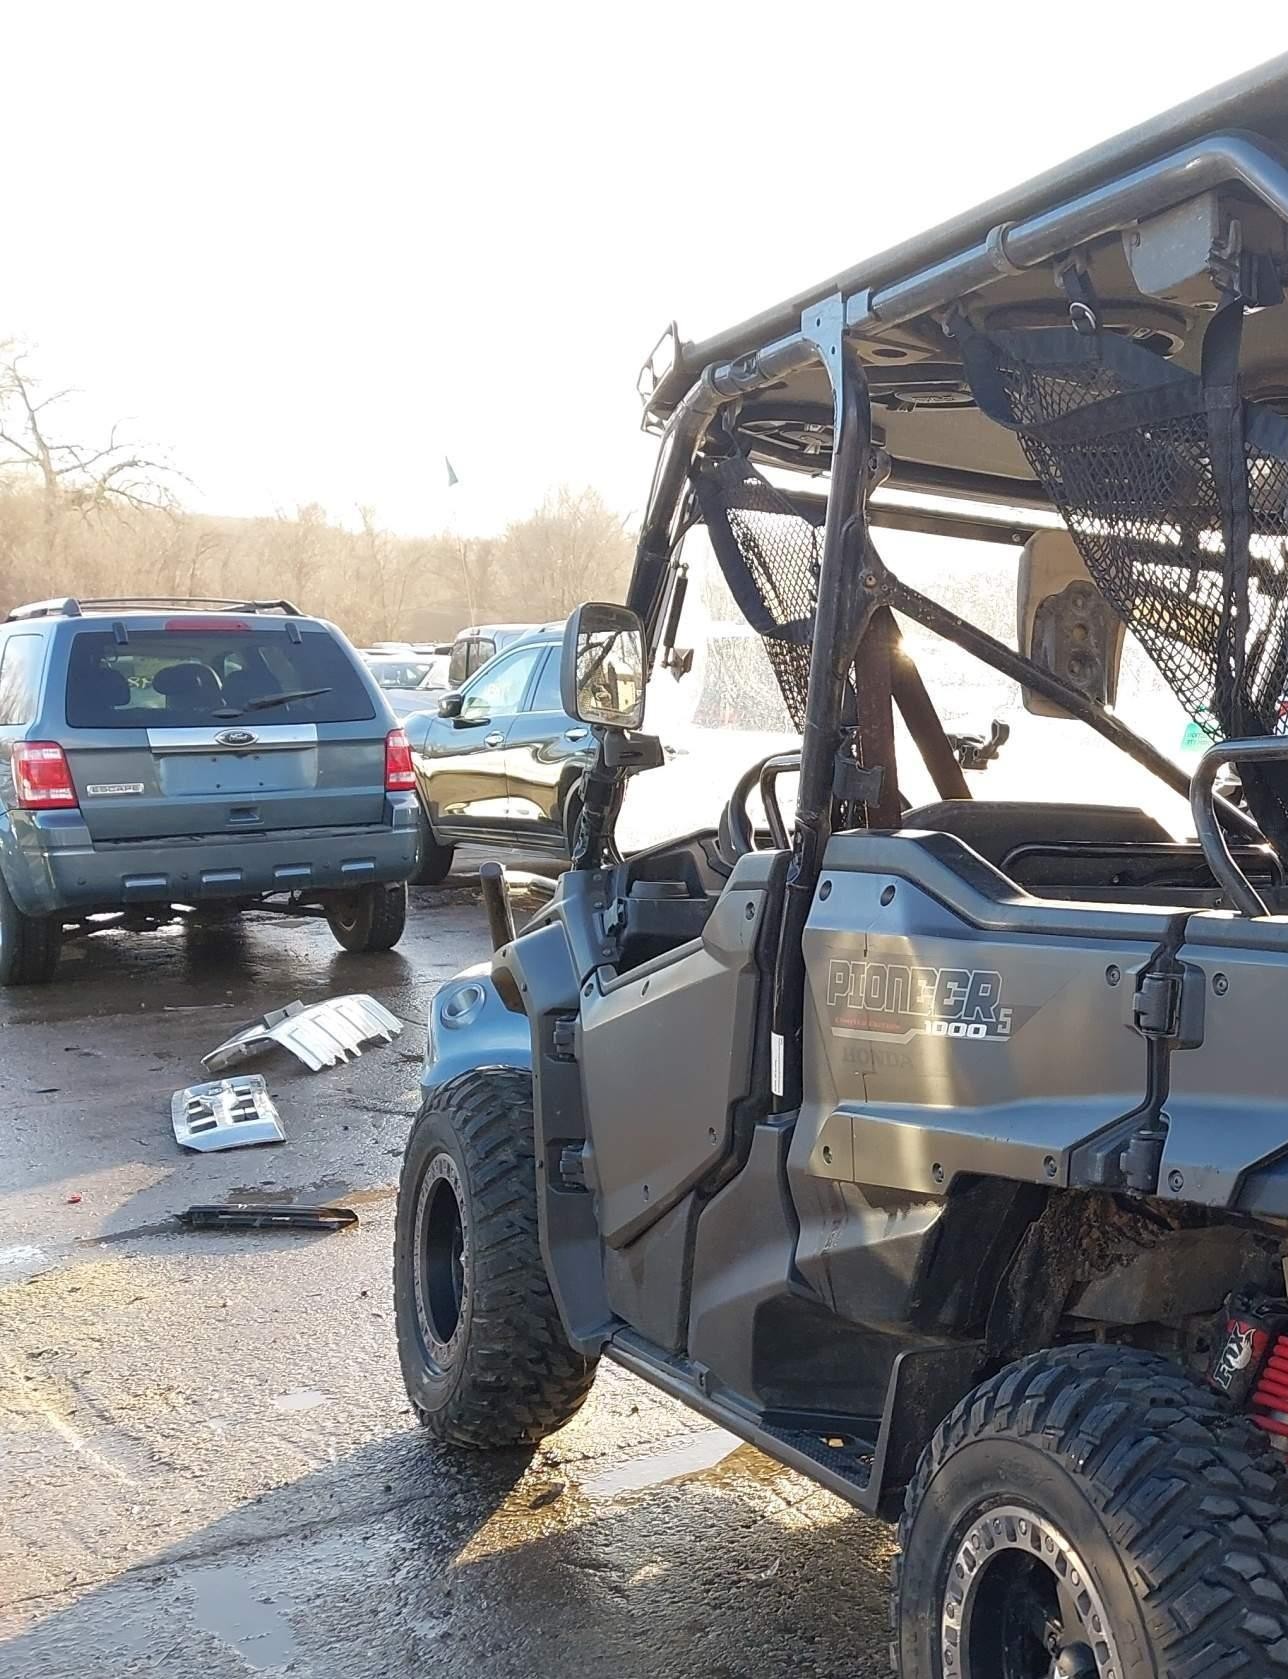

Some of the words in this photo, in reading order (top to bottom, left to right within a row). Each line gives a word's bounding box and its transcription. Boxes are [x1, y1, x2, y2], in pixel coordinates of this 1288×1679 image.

[92, 784, 141, 793] ESCAPE
[826, 959, 1002, 1022] PIONEER
[996, 1007, 1013, 1035] 5
[924, 1020, 988, 1038] 1000
[842, 1047, 914, 1071] HONDA
[1213, 1321, 1256, 1390] FOX
